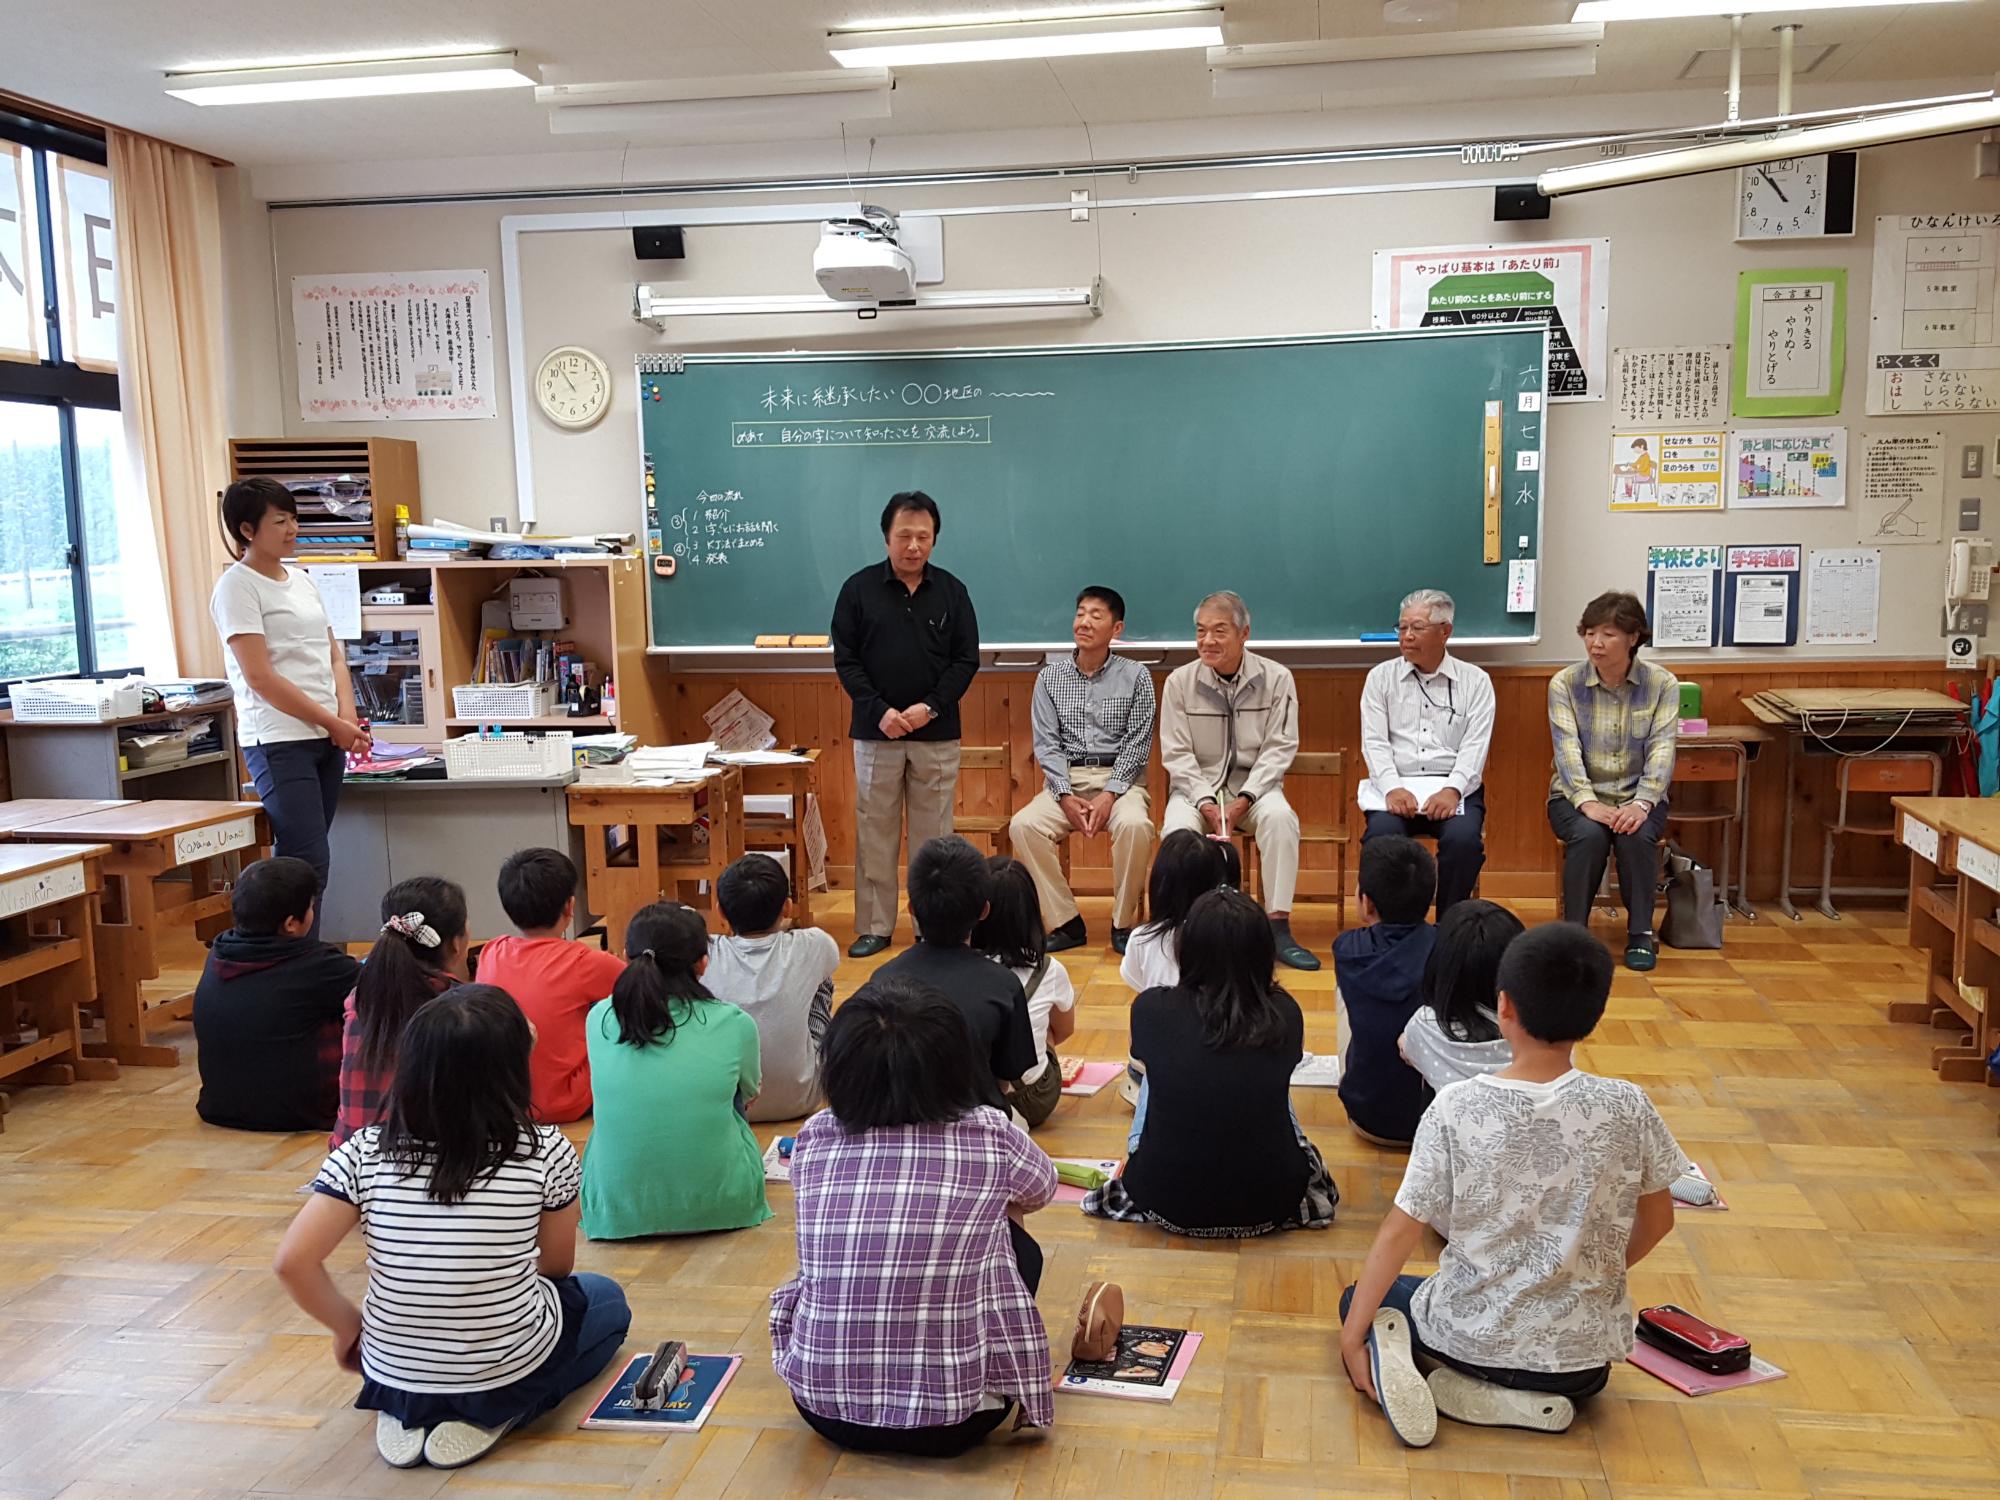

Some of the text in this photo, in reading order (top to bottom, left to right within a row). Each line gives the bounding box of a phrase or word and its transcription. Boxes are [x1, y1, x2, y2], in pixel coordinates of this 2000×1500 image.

[1778, 160, 1787, 170] 12
[1796, 163, 1800, 174] 1
[1751, 176, 1760, 186] 10
[1805, 174, 1812, 185] 2
[1746, 191, 1753, 202] 9
[1810, 189, 1816, 200] 3
[1750, 207, 1757, 217] 8
[1804, 205, 1811, 215] 4
[1762, 217, 1769, 228] 7
[1776, 221, 1783, 232] 6
[1792, 216, 1799, 227] 5
[1430, 291, 1552, 306] あたり前のことをあたり前にする
[1773, 288, 1812, 299] 合言葉
[1803, 303, 1814, 350] やりきる
[1784, 315, 1796, 361] やりぬく
[569, 357, 579, 368] 12
[1767, 329, 1779, 385] やりとげる
[1878, 354, 1936, 368] やくそく
[584, 362, 588, 372] 1
[550, 368, 559, 378] 10
[591, 371, 597, 381] 2
[1518, 363, 1540, 386] 六
[1890, 370, 1967, 384] お さない
[546, 380, 553, 390] 9
[594, 383, 600, 393] 3
[1890, 384, 1982, 397] は しらない
[550, 392, 556, 402] 8
[590, 395, 596, 405] 4
[559, 401, 565, 410] 7
[569, 406, 576, 415] 6
[582, 403, 588, 413] 5
[1663, 437, 1693, 446] せなかを
[1515, 480, 1536, 506] 水
[1649, 547, 1722, 569] 学校だより
[1731, 549, 1796, 569] 学年通信
